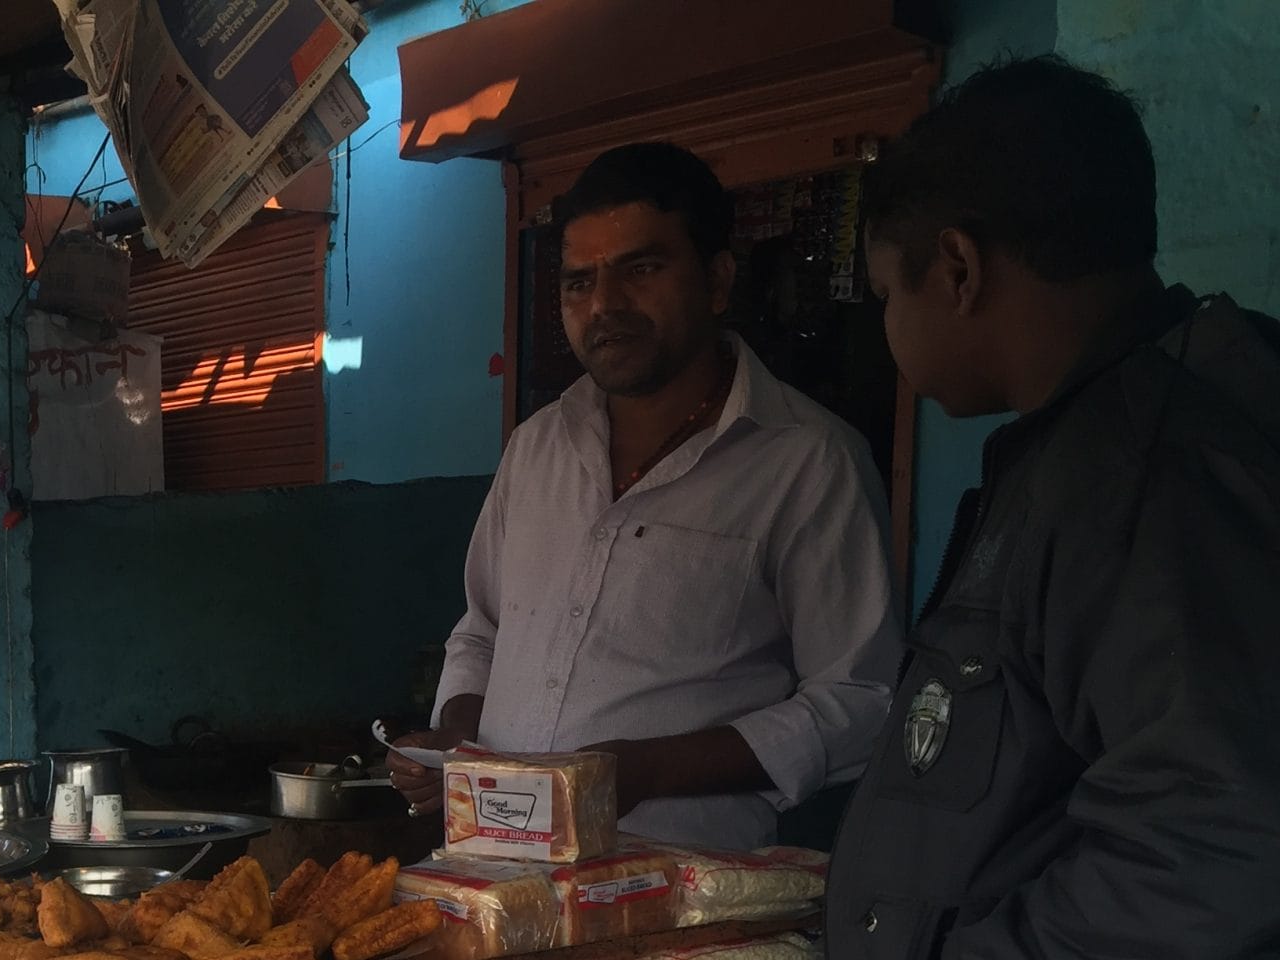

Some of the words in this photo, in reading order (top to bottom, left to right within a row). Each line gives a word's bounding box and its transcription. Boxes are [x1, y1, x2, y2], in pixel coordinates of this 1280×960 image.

[487, 799, 508, 808] Good
[496, 807, 527, 817] Morning
[509, 831, 544, 841] BREAD
